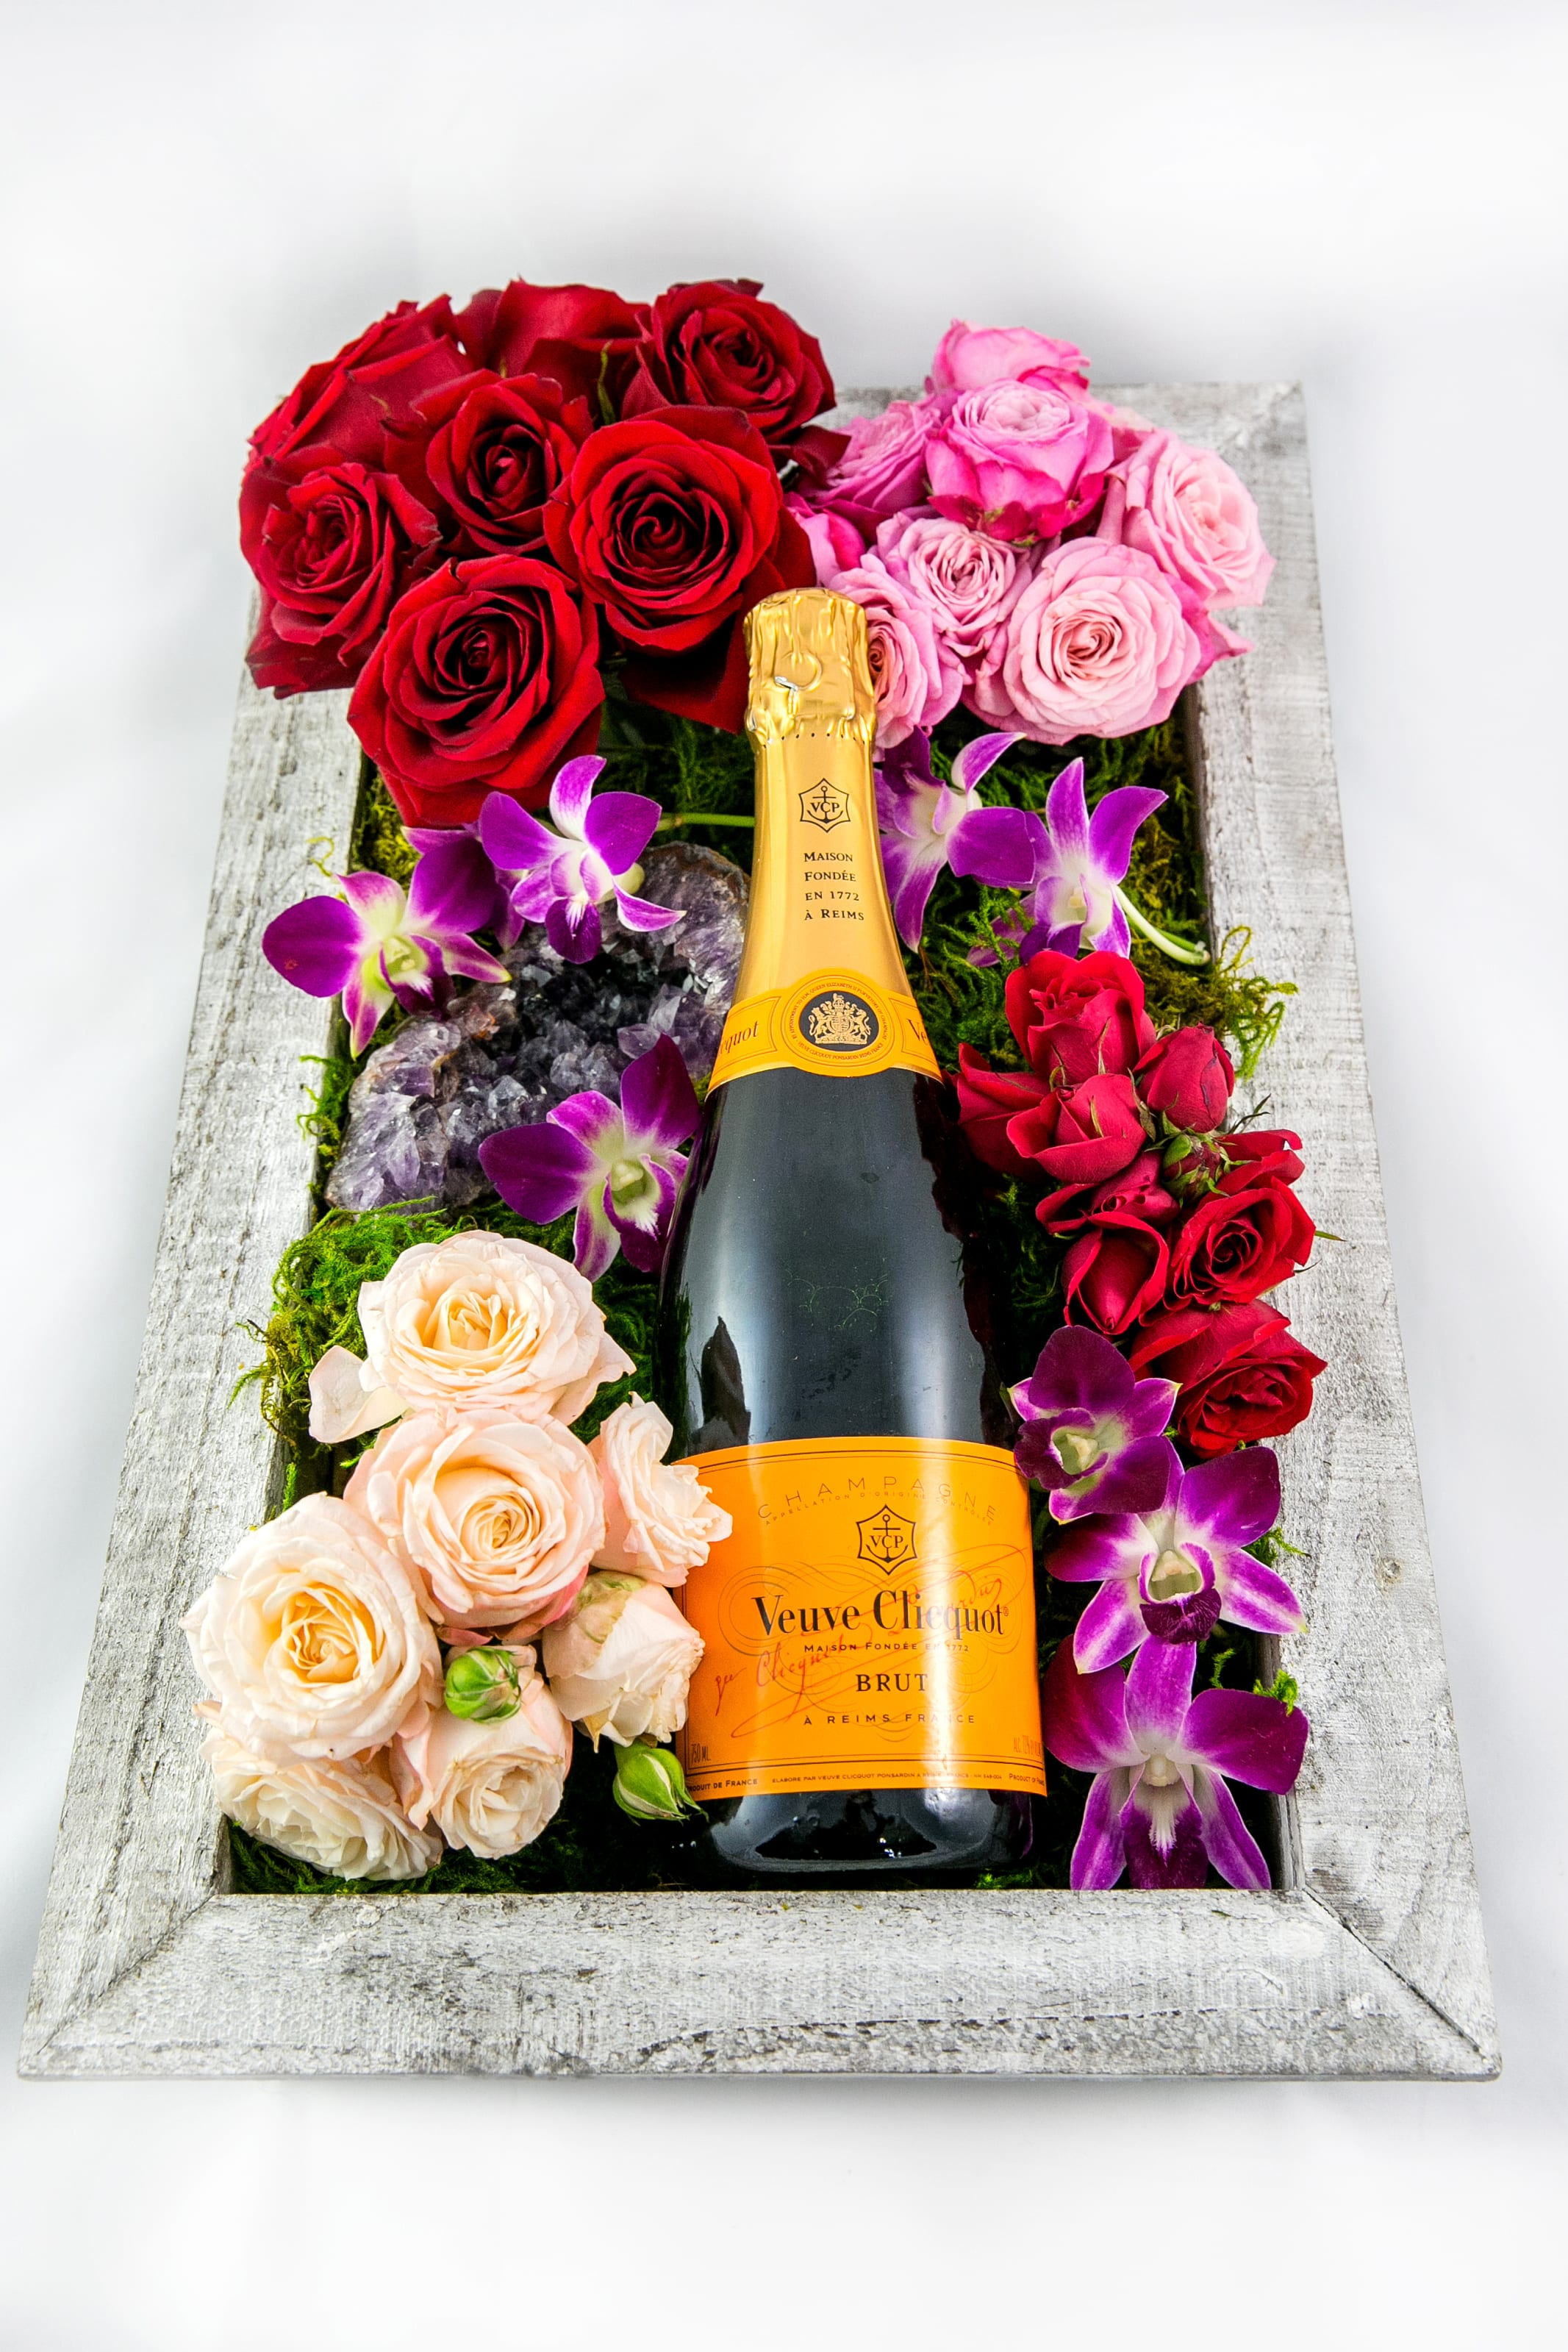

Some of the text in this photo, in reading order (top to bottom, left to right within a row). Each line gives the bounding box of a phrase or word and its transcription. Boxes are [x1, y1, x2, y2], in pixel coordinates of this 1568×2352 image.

[810, 801, 840, 812] VCP
[803, 851, 853, 862] MAISON
[804, 870, 856, 882] FONDÉE
[805, 891, 859, 901] EN 1772
[804, 909, 864, 921] À REIMS
[758, 1476, 995, 1520] CHAMPAGNE
[766, 1494, 850, 1526] APPELLATION
[869, 1535, 903, 1548] VCP
[751, 1594, 860, 1635] Veuve
[804, 1644, 857, 1652] MAISON
[866, 1641, 917, 1651] FONDÉE
[856, 1673, 928, 1692] BRUT
[803, 1715, 812, 1725] À
[827, 1714, 889, 1724] REIMS
[713, 1781, 723, 1790] DE
[725, 1779, 759, 1788] FRANCE
